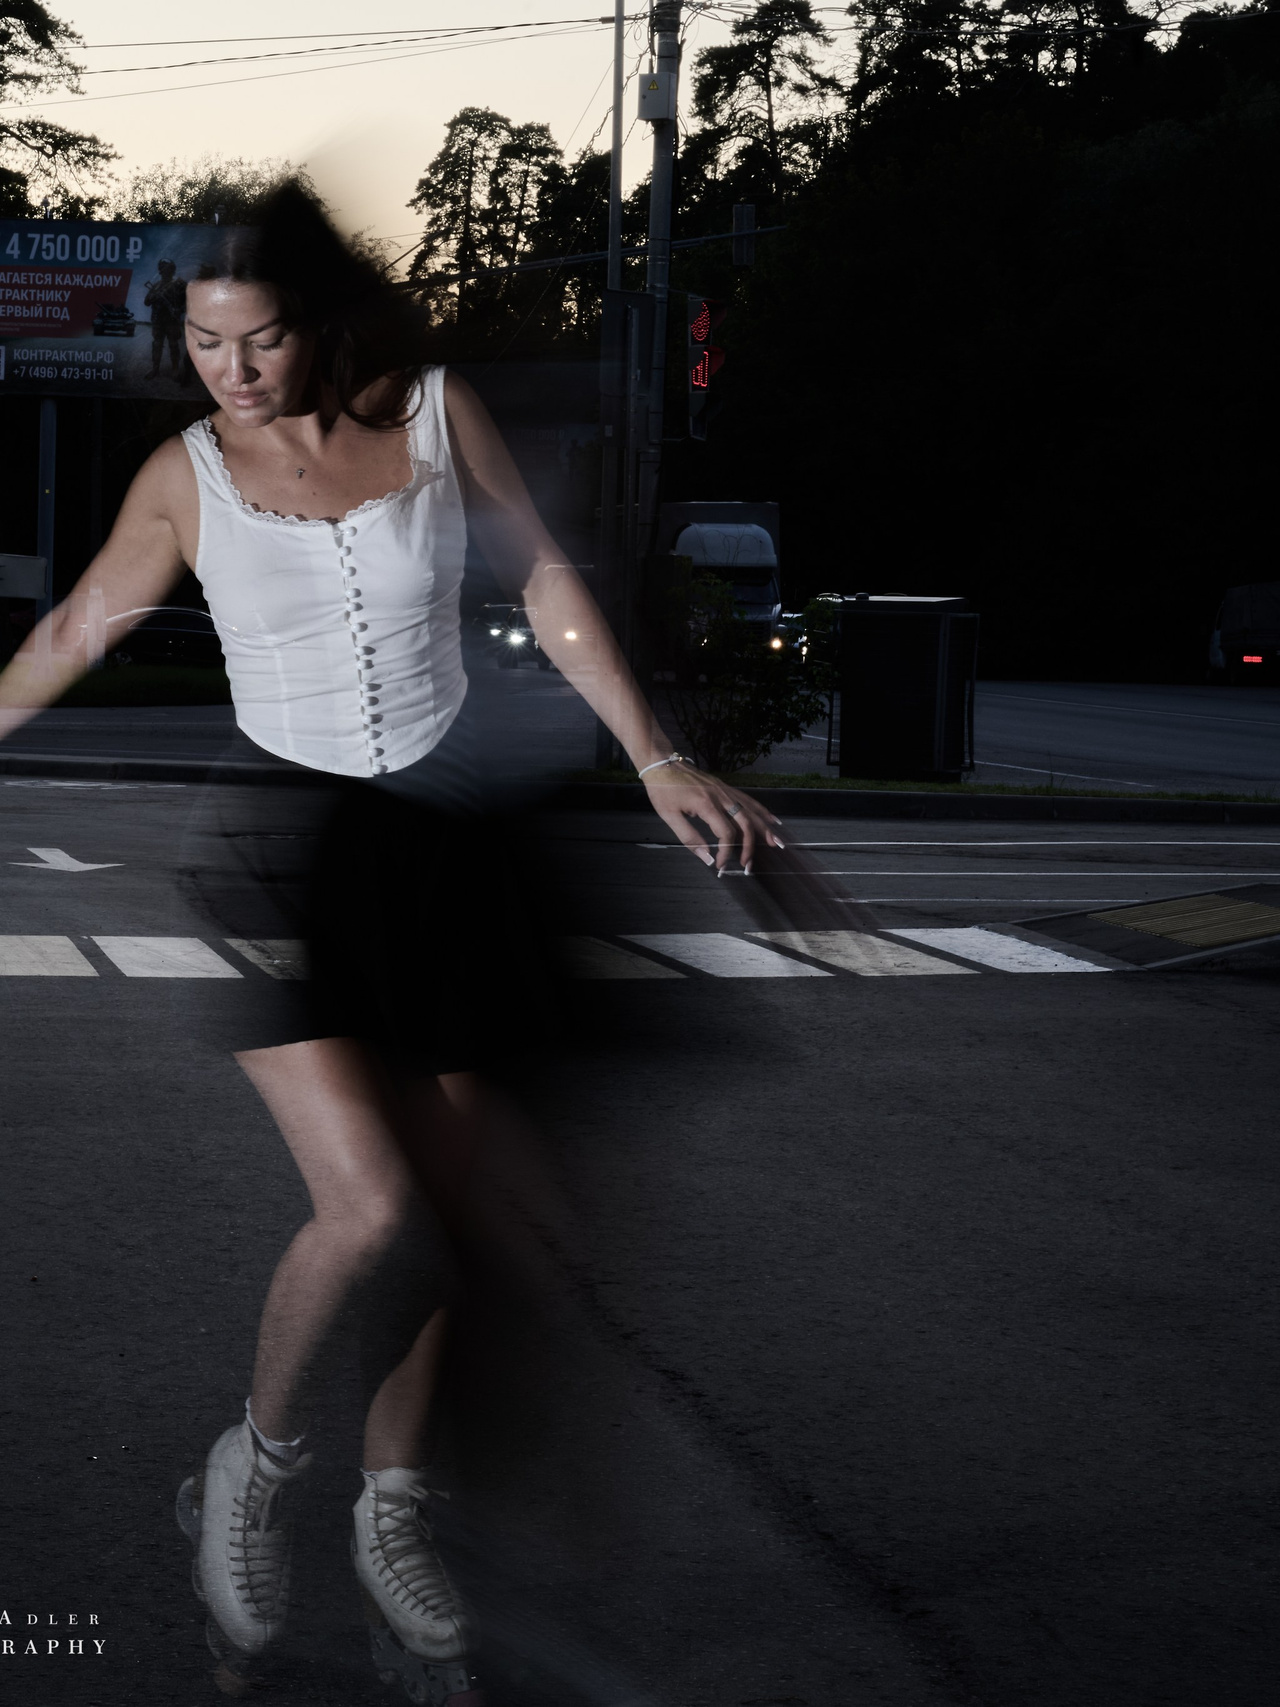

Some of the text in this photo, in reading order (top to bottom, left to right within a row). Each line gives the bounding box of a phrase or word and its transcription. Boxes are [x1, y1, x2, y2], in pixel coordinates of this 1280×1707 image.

[6, 233, 20, 259] 4
[27, 233, 70, 261] 750
[76, 234, 120, 262] 000
[126, 236, 142, 263] ₽
[55, 273, 122, 288] КАЖДОМУ
[45, 306, 70, 320] ГОД
[13, 348, 114, 364] КОНТРАКТМО.РФ
[13, 367, 114, 381] +7 (496) 473-91-01
